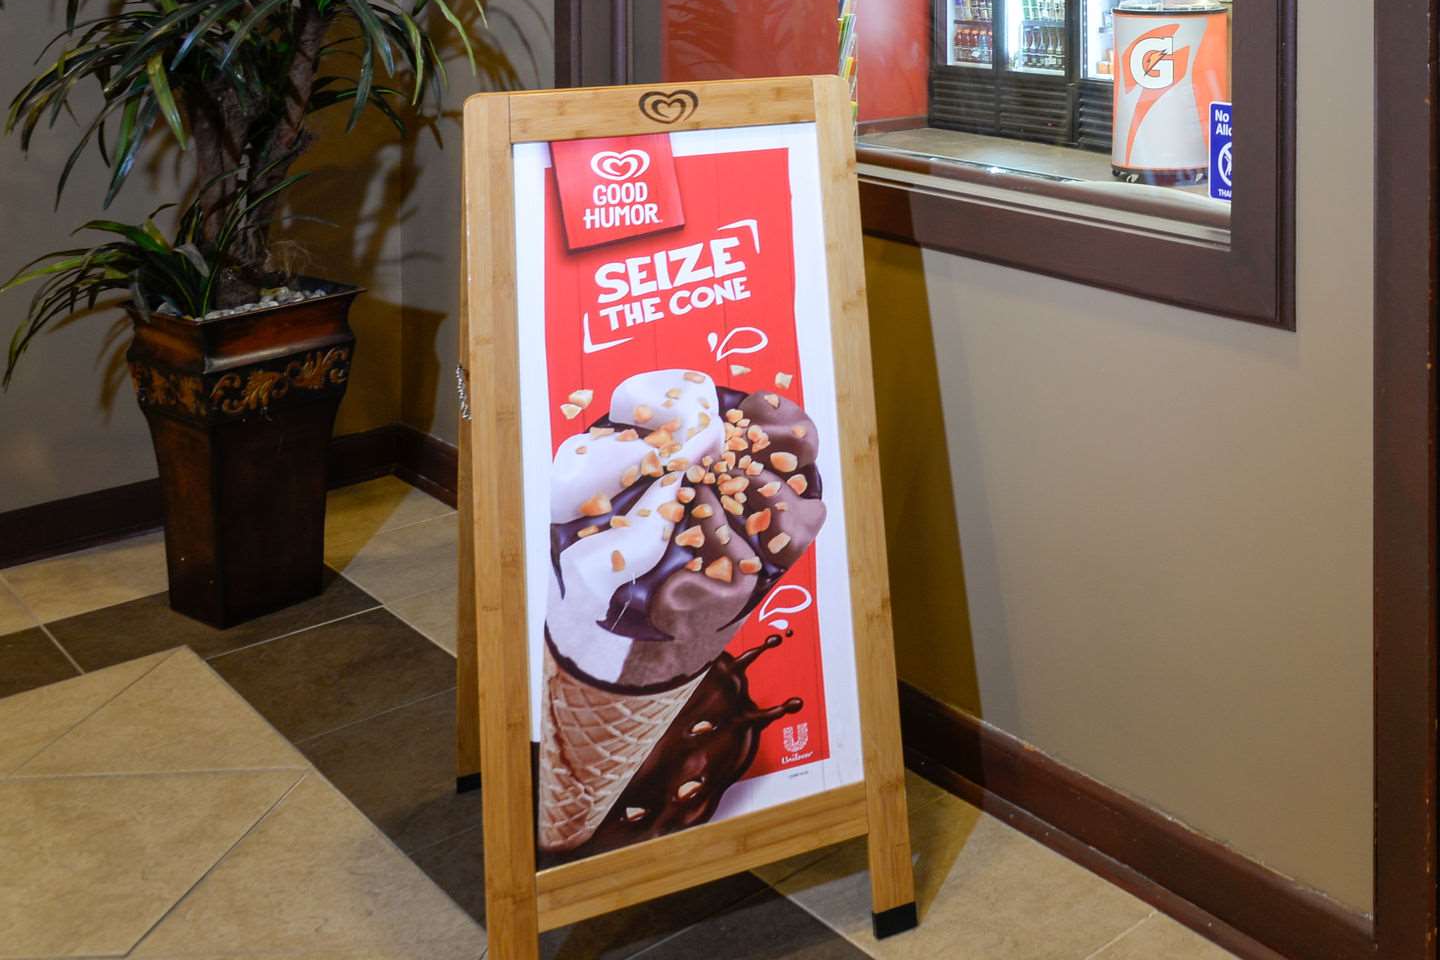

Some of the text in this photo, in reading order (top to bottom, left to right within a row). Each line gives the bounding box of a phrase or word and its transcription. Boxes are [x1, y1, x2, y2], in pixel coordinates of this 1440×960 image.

[1129, 37, 1175, 90] G
[1215, 109, 1230, 122] No
[592, 182, 648, 206] GOOD
[583, 203, 660, 229] HUMOR
[594, 236, 747, 303] SEIZE
[599, 276, 751, 330] THE CONE
